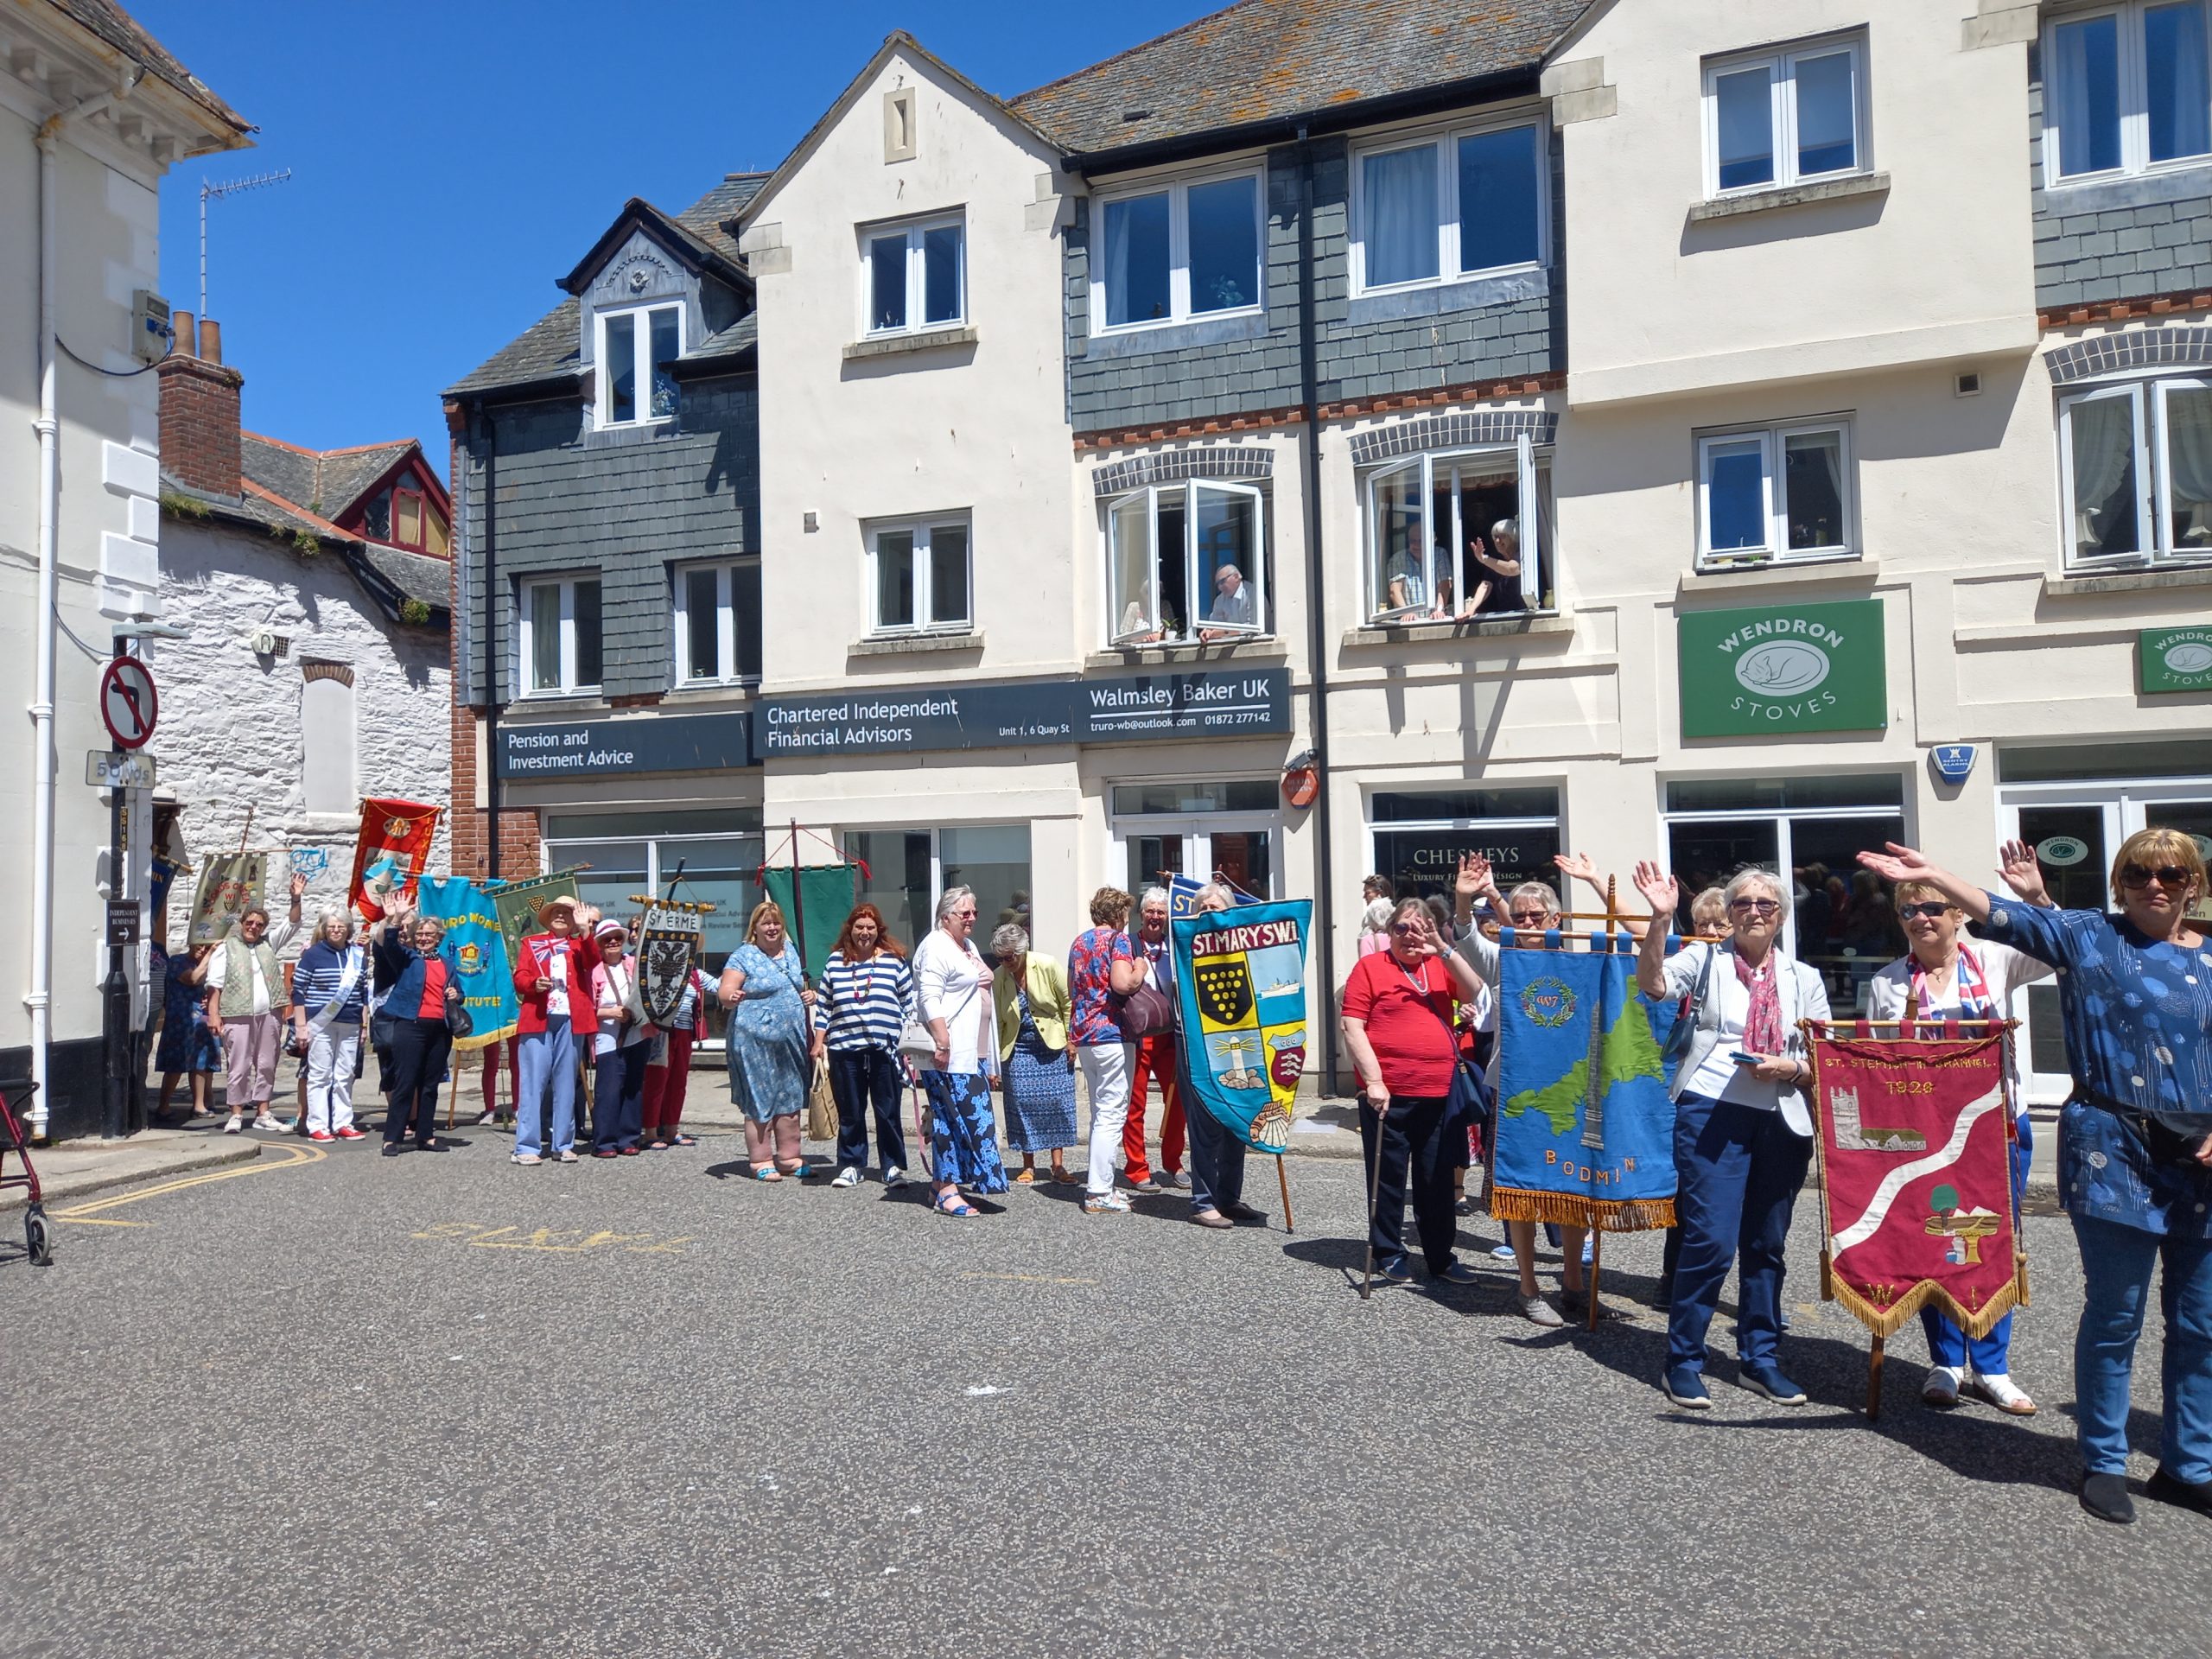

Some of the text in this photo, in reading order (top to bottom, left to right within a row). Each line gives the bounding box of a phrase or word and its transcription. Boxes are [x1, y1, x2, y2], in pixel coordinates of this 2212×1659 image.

[1717, 619, 1845, 653] WENDRON
[2154, 632, 2212, 650] WENDRO
[2162, 672, 2212, 684] STOVE
[1090, 678, 1270, 708] Walmsley Baker UK
[767, 698, 958, 724] Chartered Independent
[1731, 690, 1836, 720] STOVES
[1205, 714, 1234, 725] 01872
[1236, 711, 1271, 724] 277142
[508, 729, 588, 749] Pension and
[767, 727, 912, 747] Financial Advisors
[999, 723, 1070, 737] Unit 1, 6 Quay St
[509, 750, 633, 770] Investment Advice
[97, 762, 121, 778] 50
[1414, 847, 1520, 865] CHESEYS
[1173, 894, 1196, 913] ST
[442, 912, 501, 932] URO WOME
[666, 916, 696, 930] ERME
[462, 996, 501, 1008] ITUTE
[1824, 1058, 1846, 1068] ST.
[1545, 1150, 1636, 1185] BODMIN
